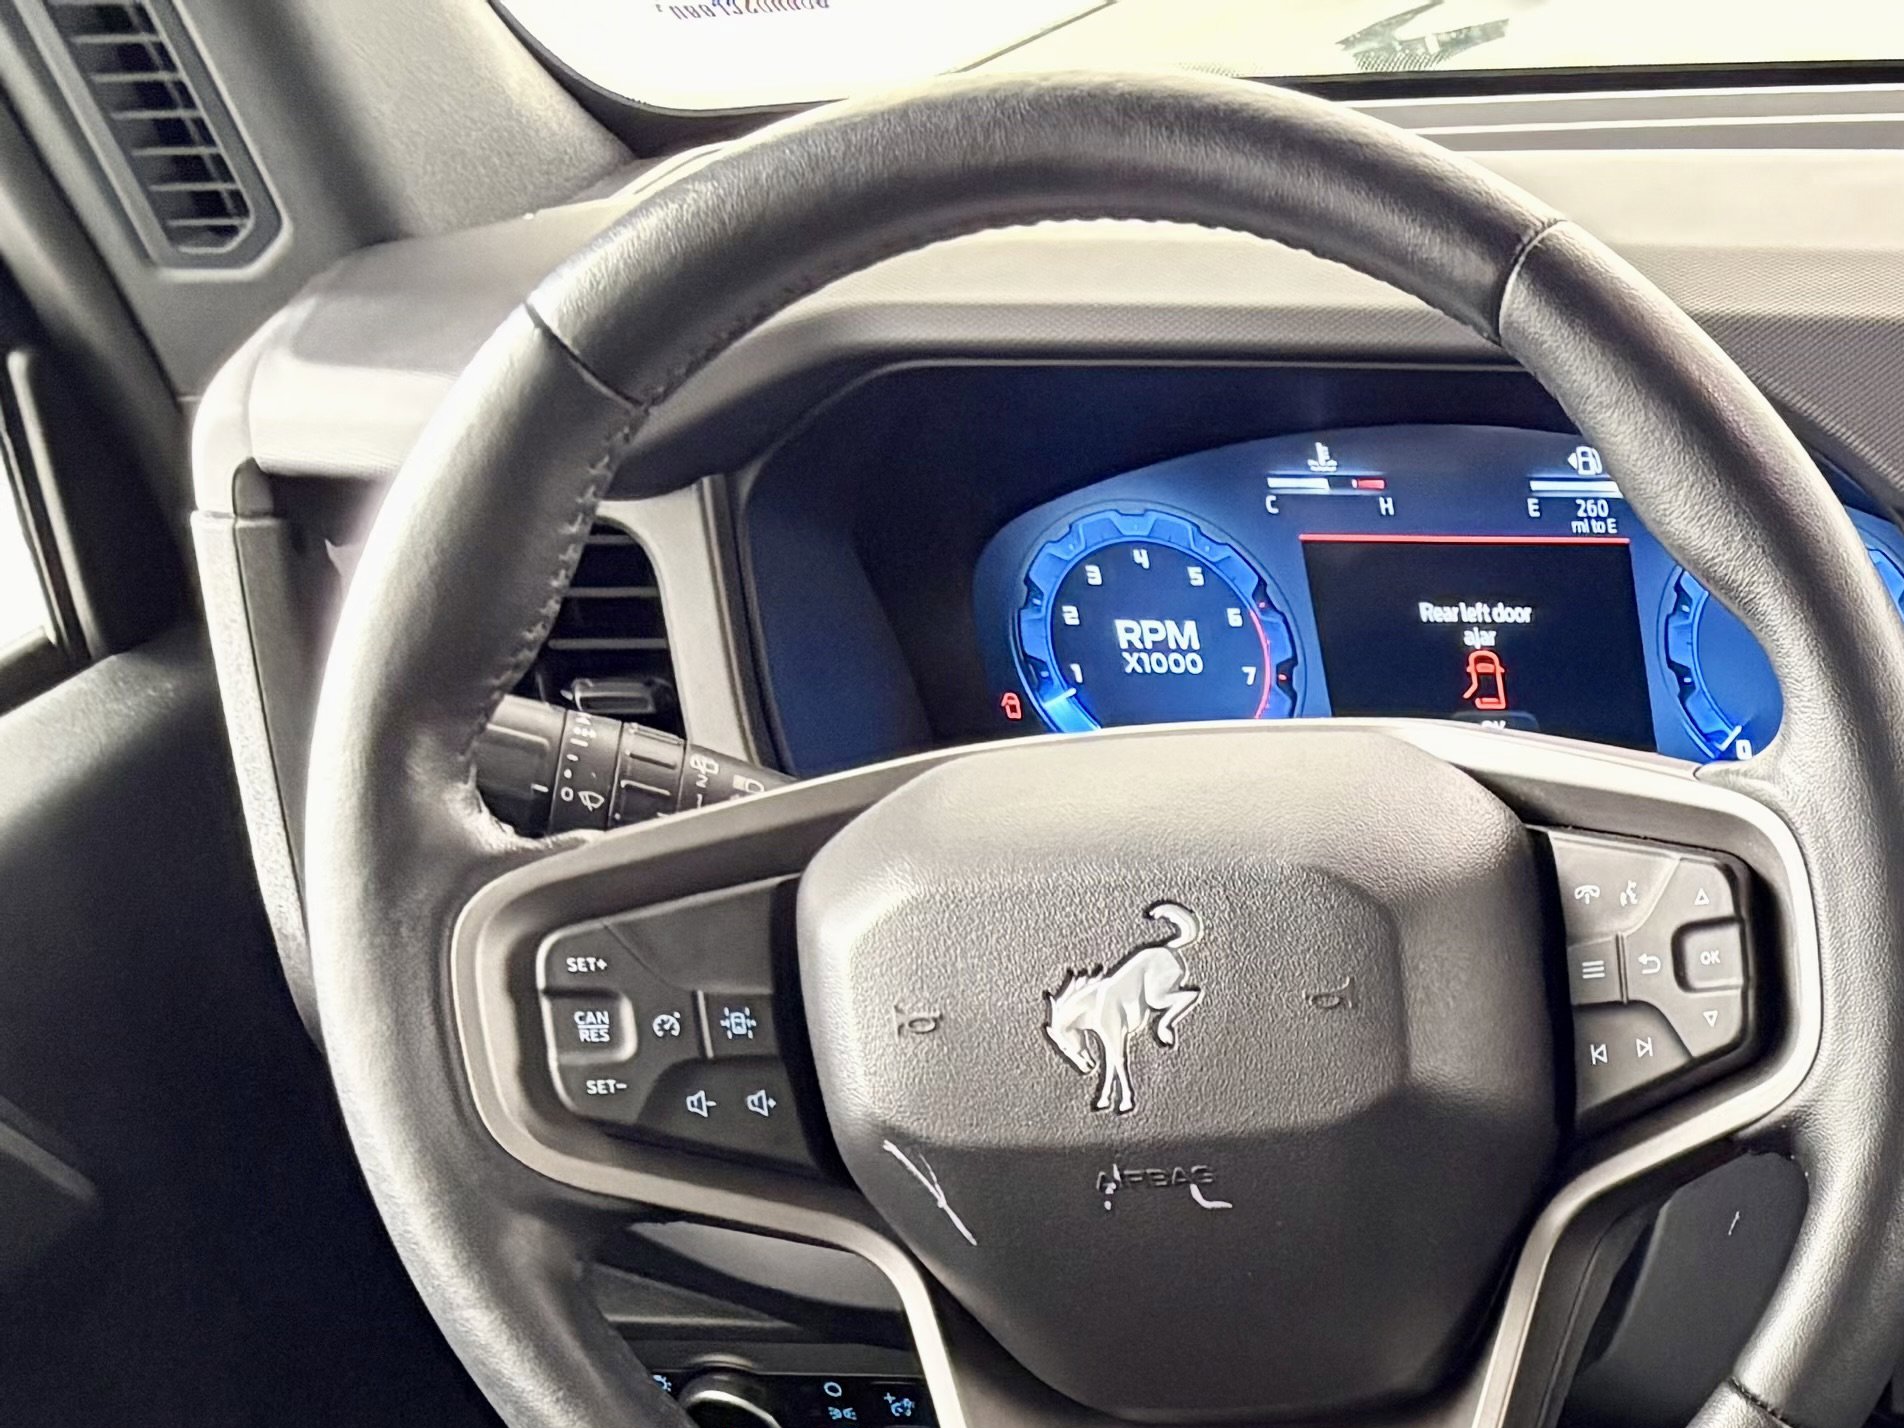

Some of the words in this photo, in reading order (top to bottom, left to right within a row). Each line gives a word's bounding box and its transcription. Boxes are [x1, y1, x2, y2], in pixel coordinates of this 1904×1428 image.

[1265, 495, 1280, 515] C
[1379, 497, 1395, 516] H
[1527, 499, 1541, 517] E
[1576, 499, 1609, 518] 260
[1590, 519, 1606, 534] to
[1606, 519, 1618, 534] E
[1132, 549, 1151, 570] 4
[1084, 564, 1103, 586] 3
[1186, 566, 1205, 587] 5
[1061, 605, 1081, 626] 2
[1226, 607, 1244, 628] 6
[1418, 602, 1460, 623] Rear
[1460, 603, 1491, 624] left
[1491, 603, 1533, 624] door
[1114, 618, 1201, 650] RPM
[1463, 629, 1497, 649] ajar
[1121, 651, 1204, 675] X1000
[1069, 663, 1084, 684] 1
[1241, 666, 1257, 686] 7
[565, 956, 608, 973] SET+
[1699, 949, 1721, 965] OK
[573, 1010, 610, 1025] CAN
[578, 1028, 611, 1043] RES
[585, 1078, 628, 1095] SET-
